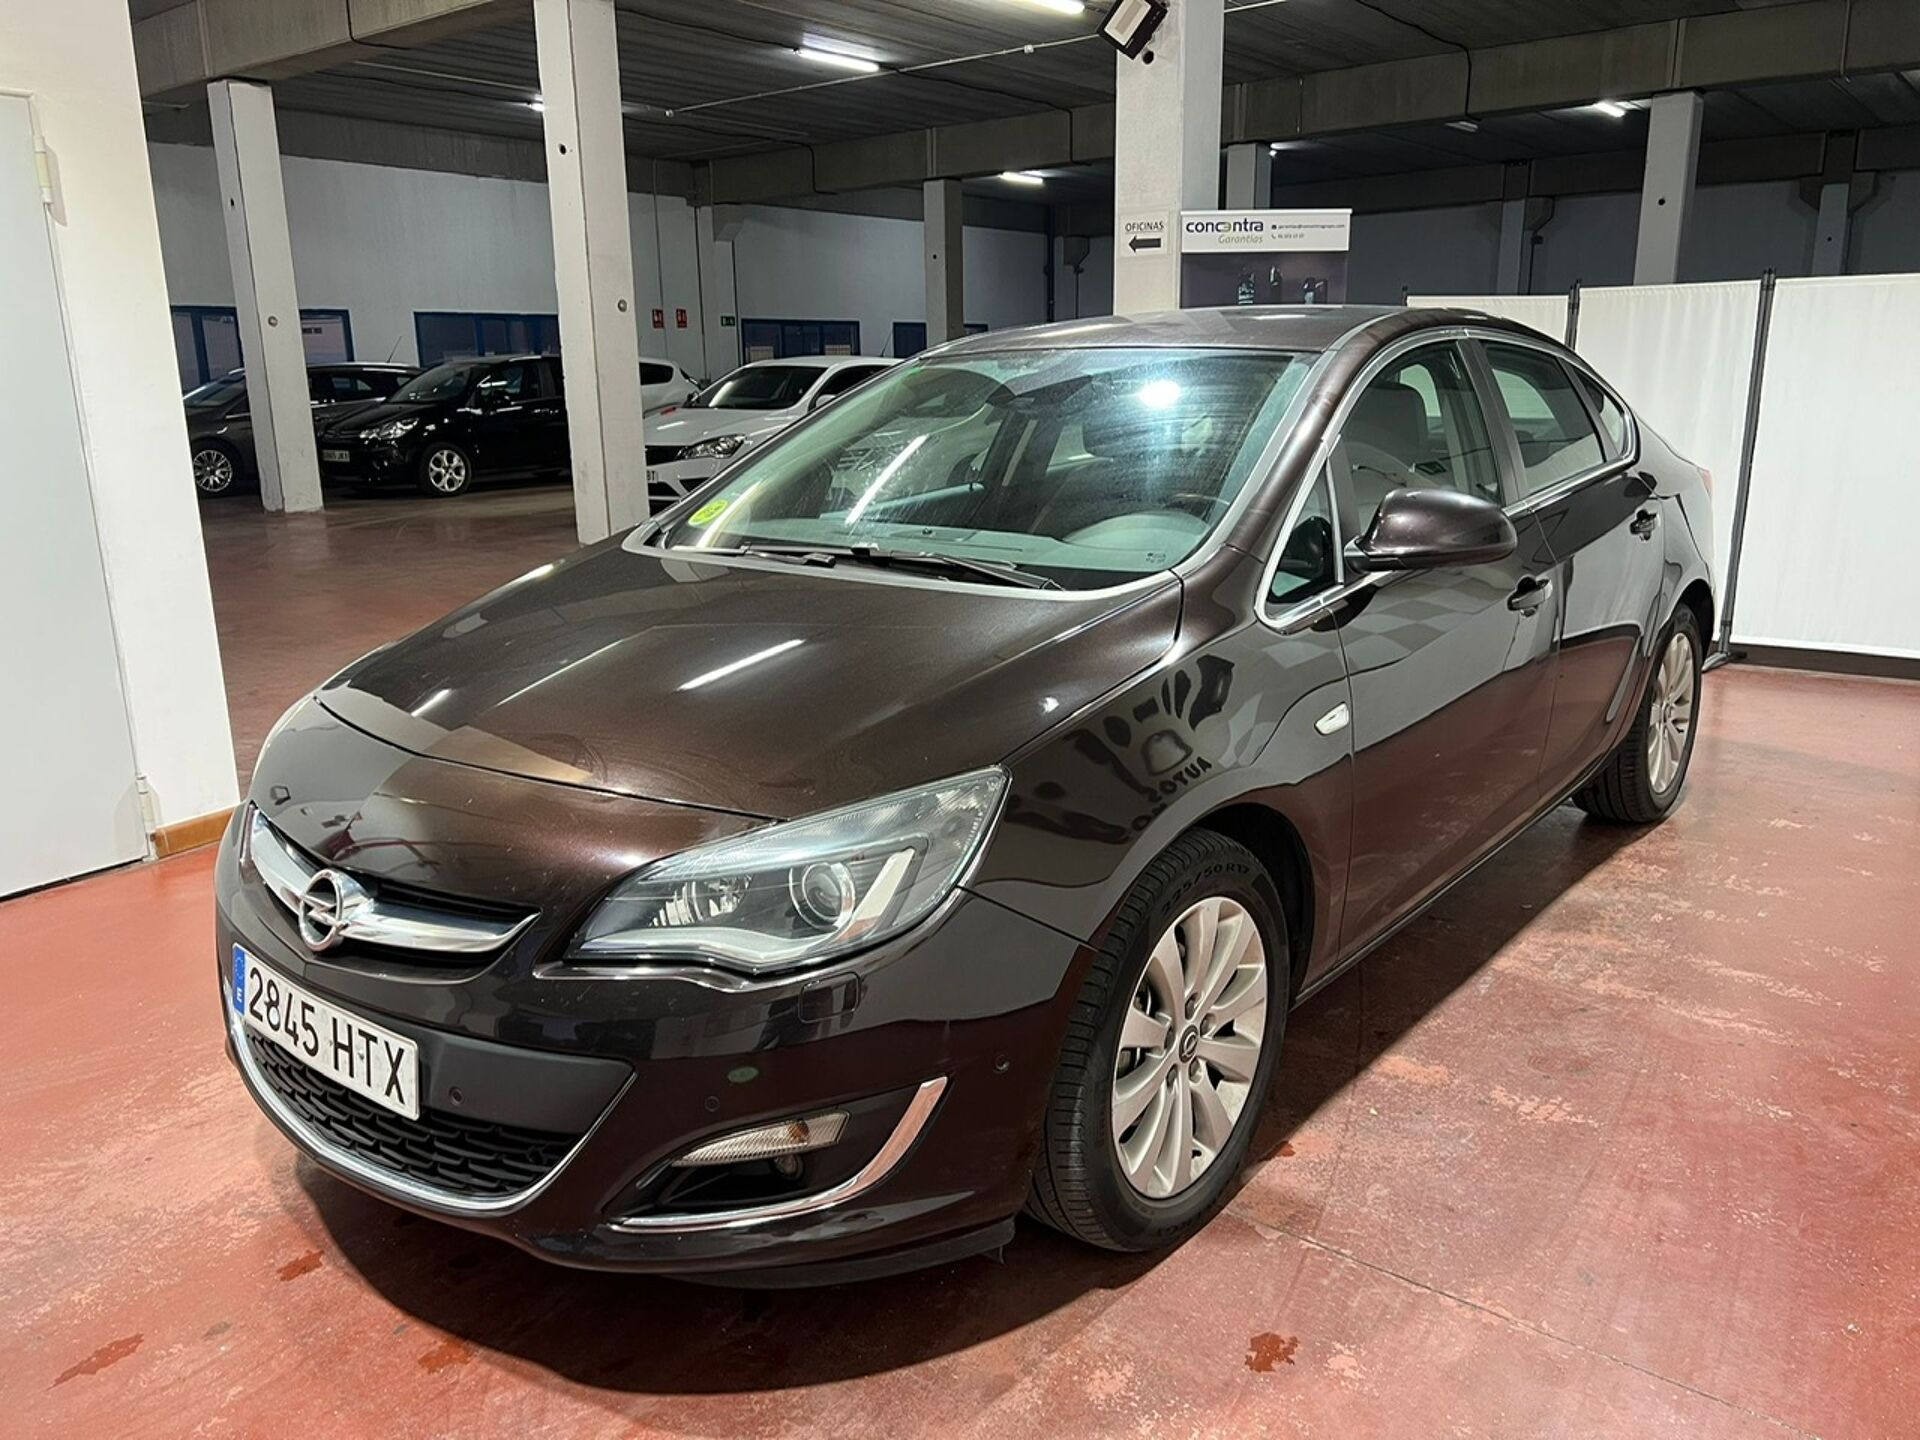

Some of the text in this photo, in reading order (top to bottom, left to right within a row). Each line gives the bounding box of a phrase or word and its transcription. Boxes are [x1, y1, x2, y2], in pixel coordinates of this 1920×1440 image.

[1125, 220, 1164, 232] OFICINAS
[248, 966, 405, 1105] 2845 HTX
